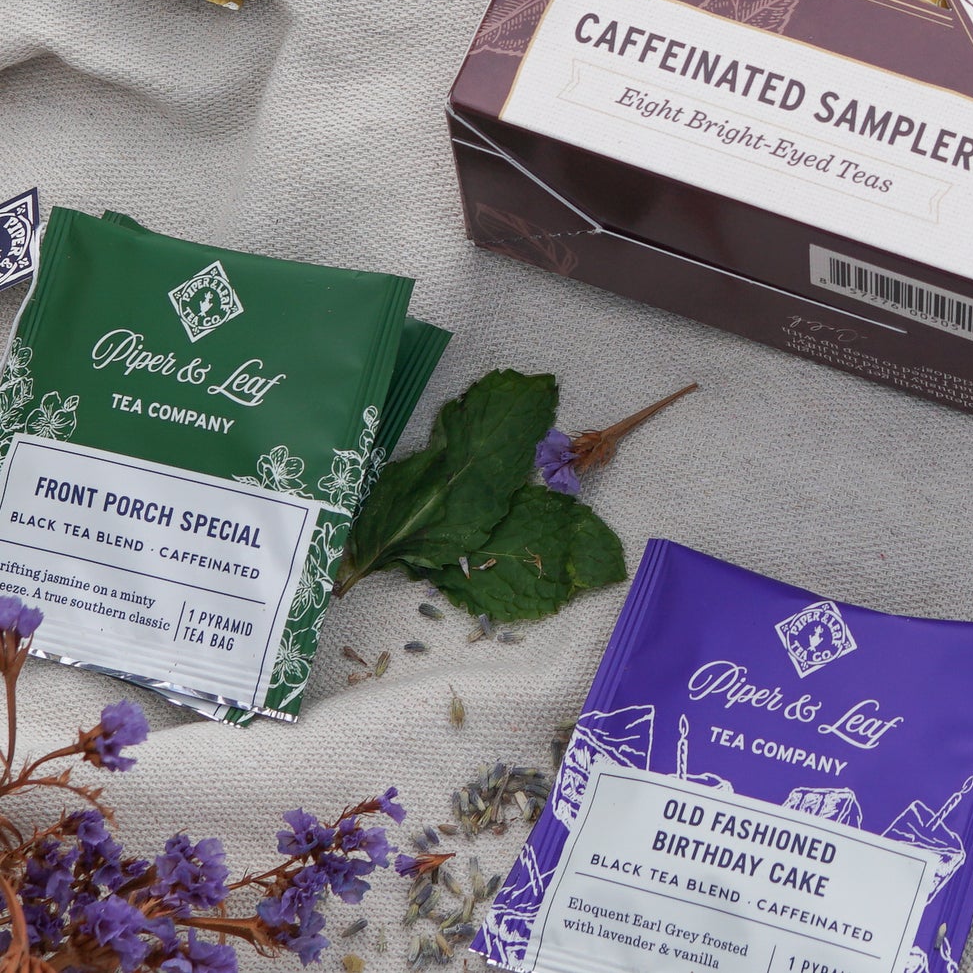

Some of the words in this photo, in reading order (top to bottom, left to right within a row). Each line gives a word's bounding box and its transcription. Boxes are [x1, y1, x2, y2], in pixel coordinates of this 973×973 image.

[574, 12, 806, 112] CAFFEINATED
[614, 86, 685, 123] Eight
[683, 109, 836, 173] Bright-Eyed
[835, 159, 893, 193] Teas
[91, 328, 178, 373] Piper
[175, 355, 212, 383] &
[207, 357, 286, 407] Leaf
[112, 393, 142, 415] TEA
[148, 402, 235, 434] COMPANY
[10, 511, 57, 532] BLACK
[63, 522, 90, 540] TEA
[96, 530, 144, 552] BLEND
[159, 546, 260, 580] CAFFEINATED
[34, 476, 99, 509] FRONT
[102, 491, 174, 527] PORCH
[179, 510, 261, 549] SPECIAL
[687, 659, 784, 714] Piper
[782, 696, 824, 724] &
[818, 699, 905, 751] Leaf
[710, 726, 745, 751] TEA
[751, 738, 848, 776] COMPANY
[651, 829, 764, 877] BIRTHDAY
[768, 862, 830, 898] CAKE
[663, 799, 705, 827] OLD
[710, 811, 837, 864] FASHIONED
[567, 896, 631, 924] Eloquent
[631, 913, 662, 933] Earl
[664, 923, 700, 944] Grey
[701, 932, 749, 957] frosted
[590, 853, 643, 877] BLACK
[650, 868, 679, 887] TEA
[686, 878, 741, 903] BLEND
[756, 898, 873, 942] CAFFEINATED
[563, 919, 595, 935] with
[597, 924, 656, 952] lavender
[658, 942, 671, 956] &
[673, 948, 719, 970] vanilla
